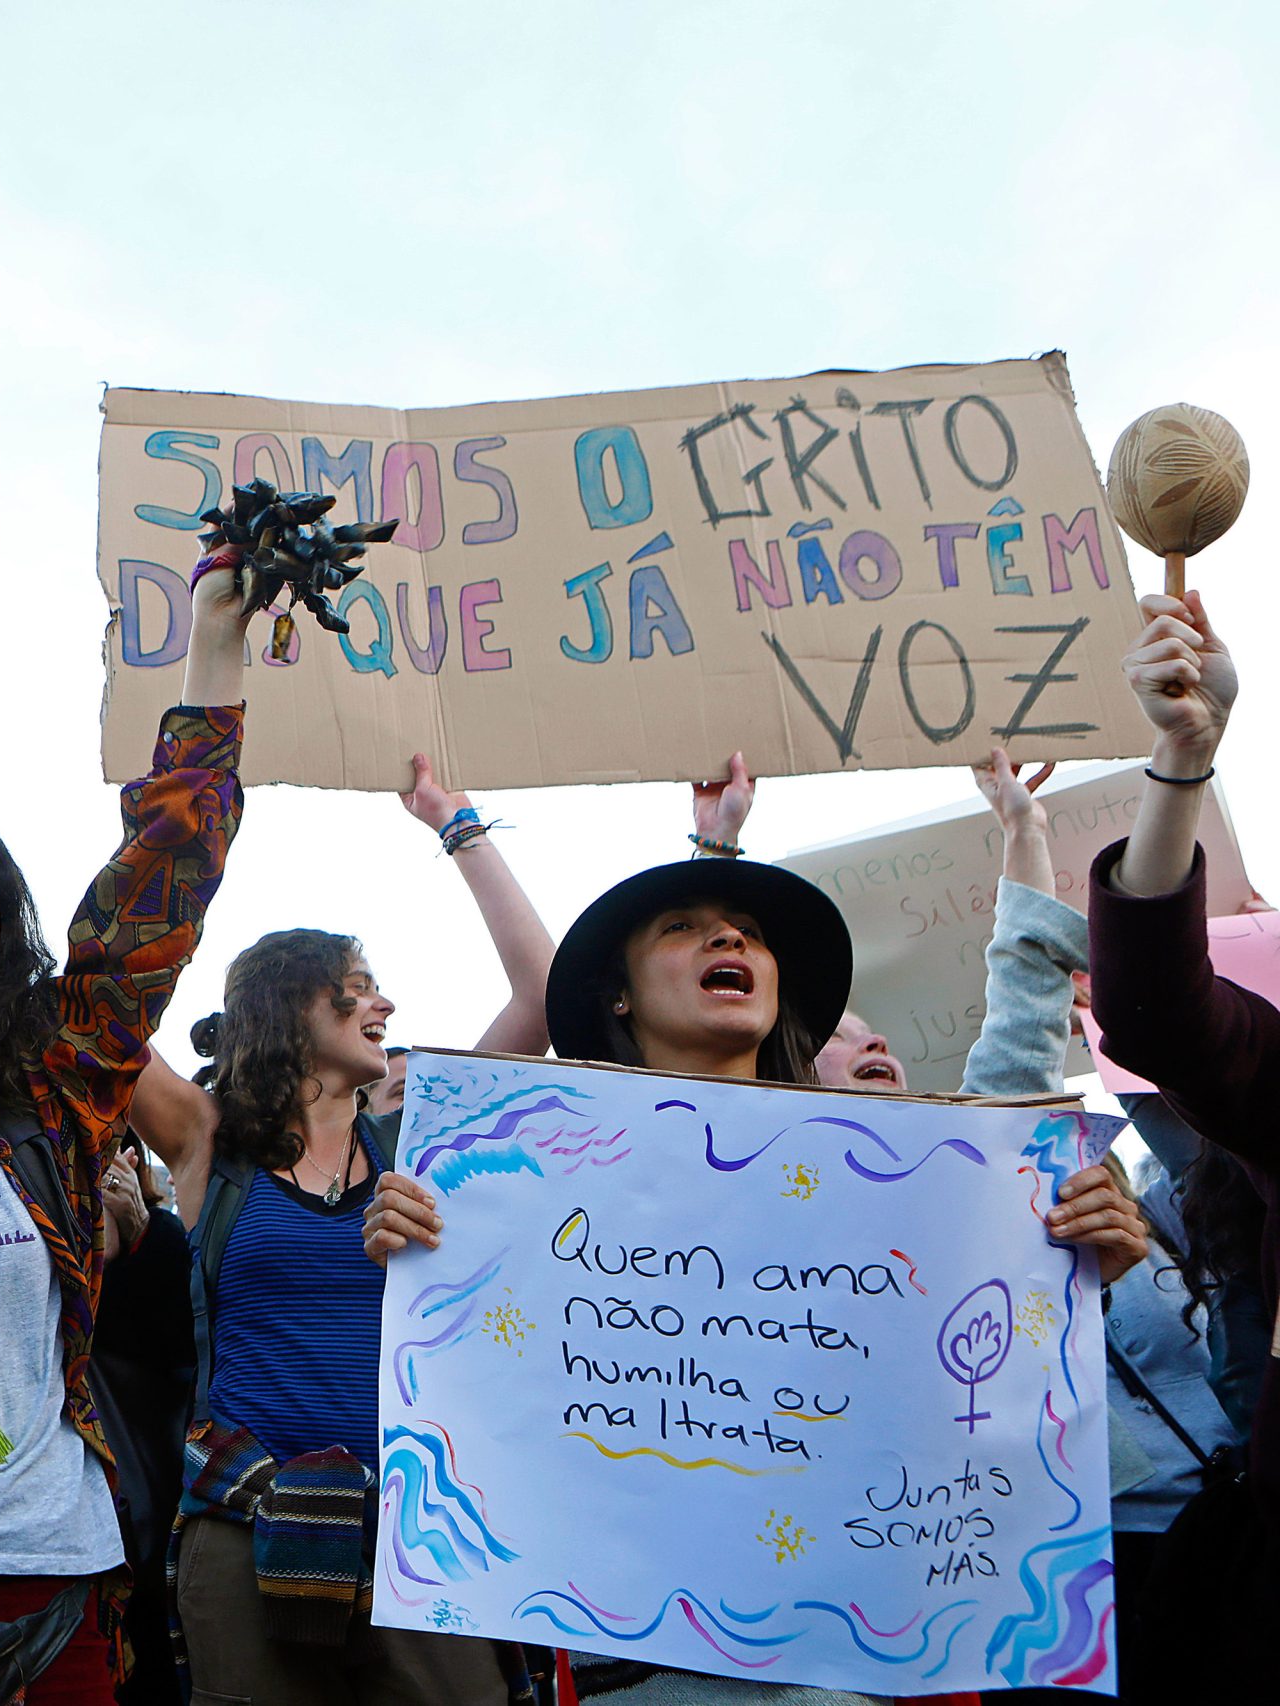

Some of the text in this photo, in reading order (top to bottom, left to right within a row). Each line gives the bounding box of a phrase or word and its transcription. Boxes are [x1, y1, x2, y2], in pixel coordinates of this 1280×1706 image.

[574, 424, 653, 530] O
[337, 579, 511, 679] QUE
[560, 531, 695, 664] JÁ
[728, 518, 903, 612] NÃO
[924, 496, 1111, 597] TÊM
[761, 617, 1101, 767] VOZ
[817, 849, 955, 896] menos
[552, 1207, 905, 1299] Quem ama
[565, 1296, 870, 1360] não mata,
[562, 1340, 850, 1415] humilha ou
[866, 1459, 1013, 1512] Juntas
